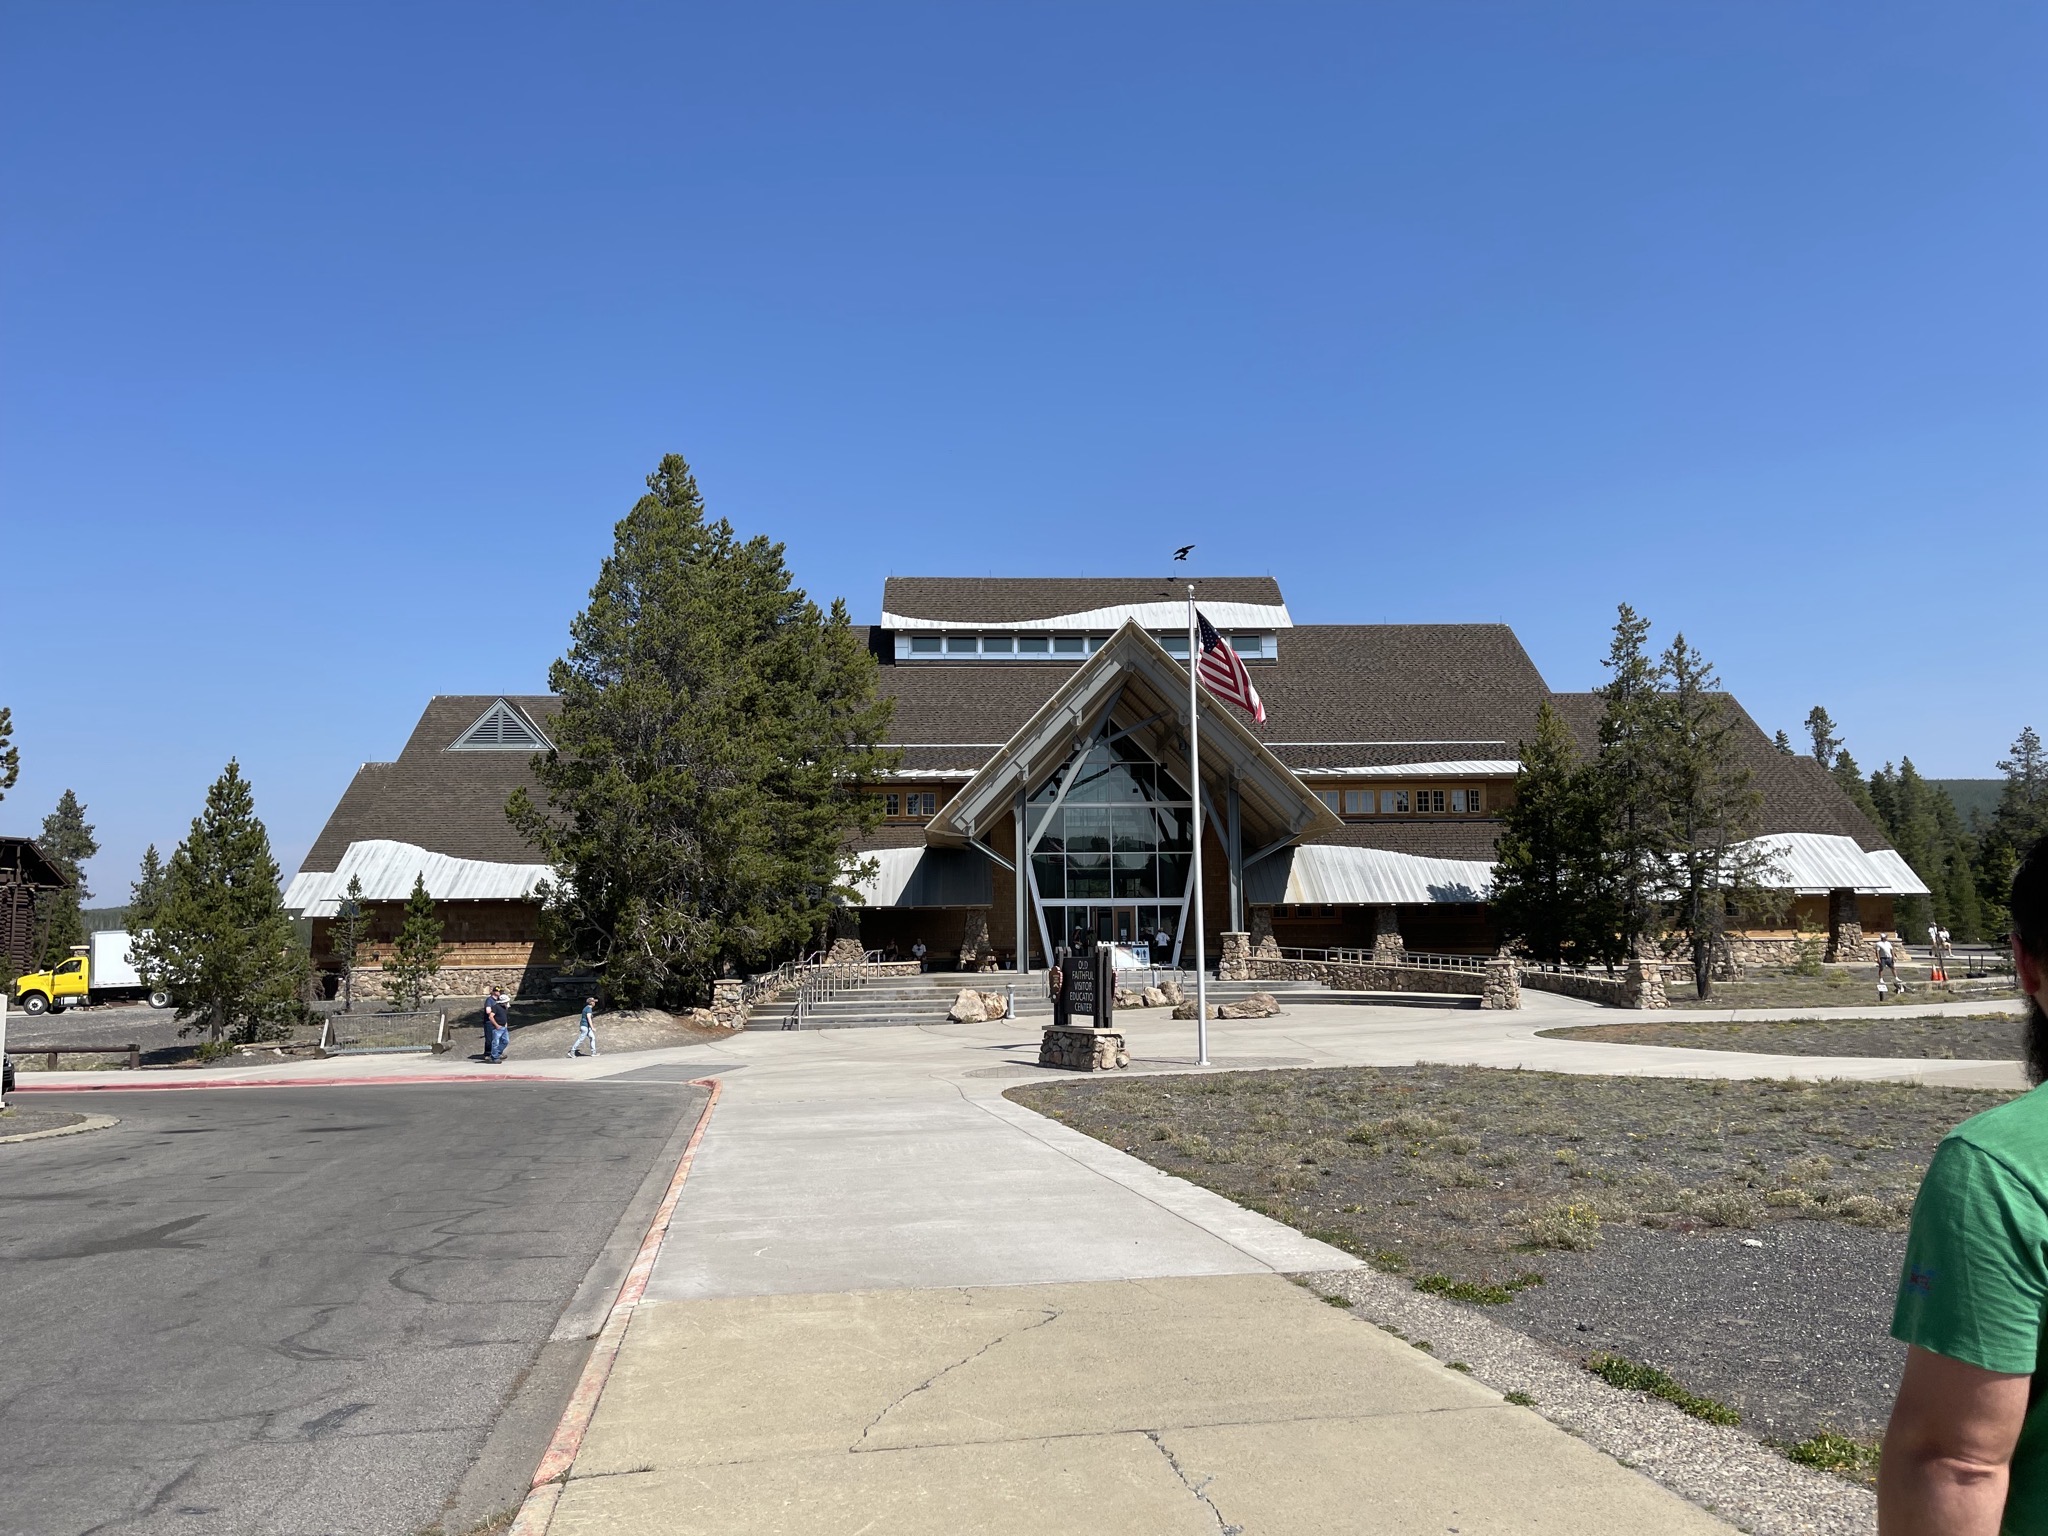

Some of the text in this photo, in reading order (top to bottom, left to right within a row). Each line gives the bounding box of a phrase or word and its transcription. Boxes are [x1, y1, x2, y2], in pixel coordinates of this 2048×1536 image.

[1078, 960, 1089, 970] OLD
[1072, 970, 1095, 980] FAITHFUL
[1074, 981, 1093, 991] VISITOR
[1070, 991, 1094, 1002] EDUCATIO
[1075, 1002, 1093, 1012] CENTER
